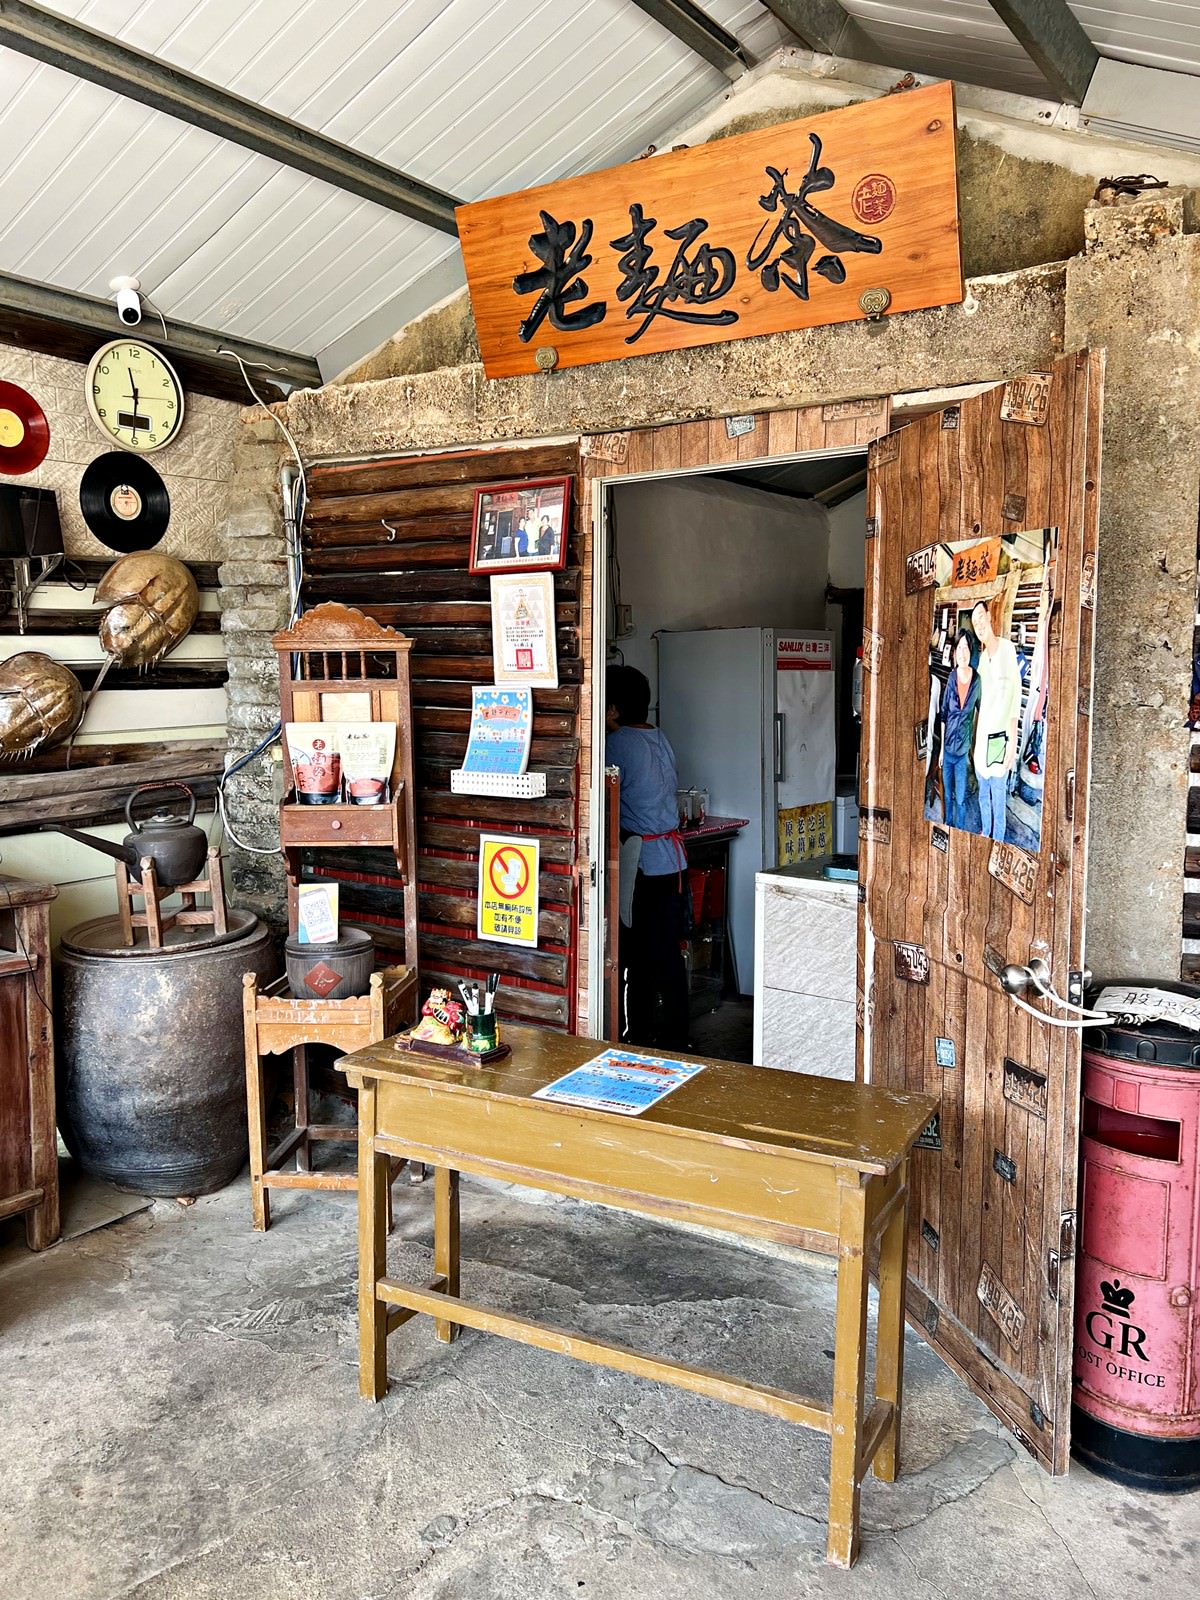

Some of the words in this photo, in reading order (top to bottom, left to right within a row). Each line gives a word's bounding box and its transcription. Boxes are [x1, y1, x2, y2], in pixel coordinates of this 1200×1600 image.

[512, 132, 882, 344] 老麵茶
[112, 351, 119, 360] 11
[129, 349, 140, 359] 12
[151, 360, 155, 368] 1
[98, 365, 110, 375] 10
[162, 379, 169, 387] 2
[93, 386, 101, 394] 9
[167, 401, 174, 409] 3
[99, 409, 107, 417] 8
[162, 421, 169, 429] 4
[113, 428, 121, 436] 7
[131, 437, 139, 446] 6
[149, 434, 156, 442] 5
[956, 545, 991, 583] 老麵茶
[778, 641, 804, 653] SANLUX
[805, 641, 830, 653] 台灣三洋
[1086, 1311, 1150, 1362] GR
[1106, 1362, 1166, 1388] OFFICE
